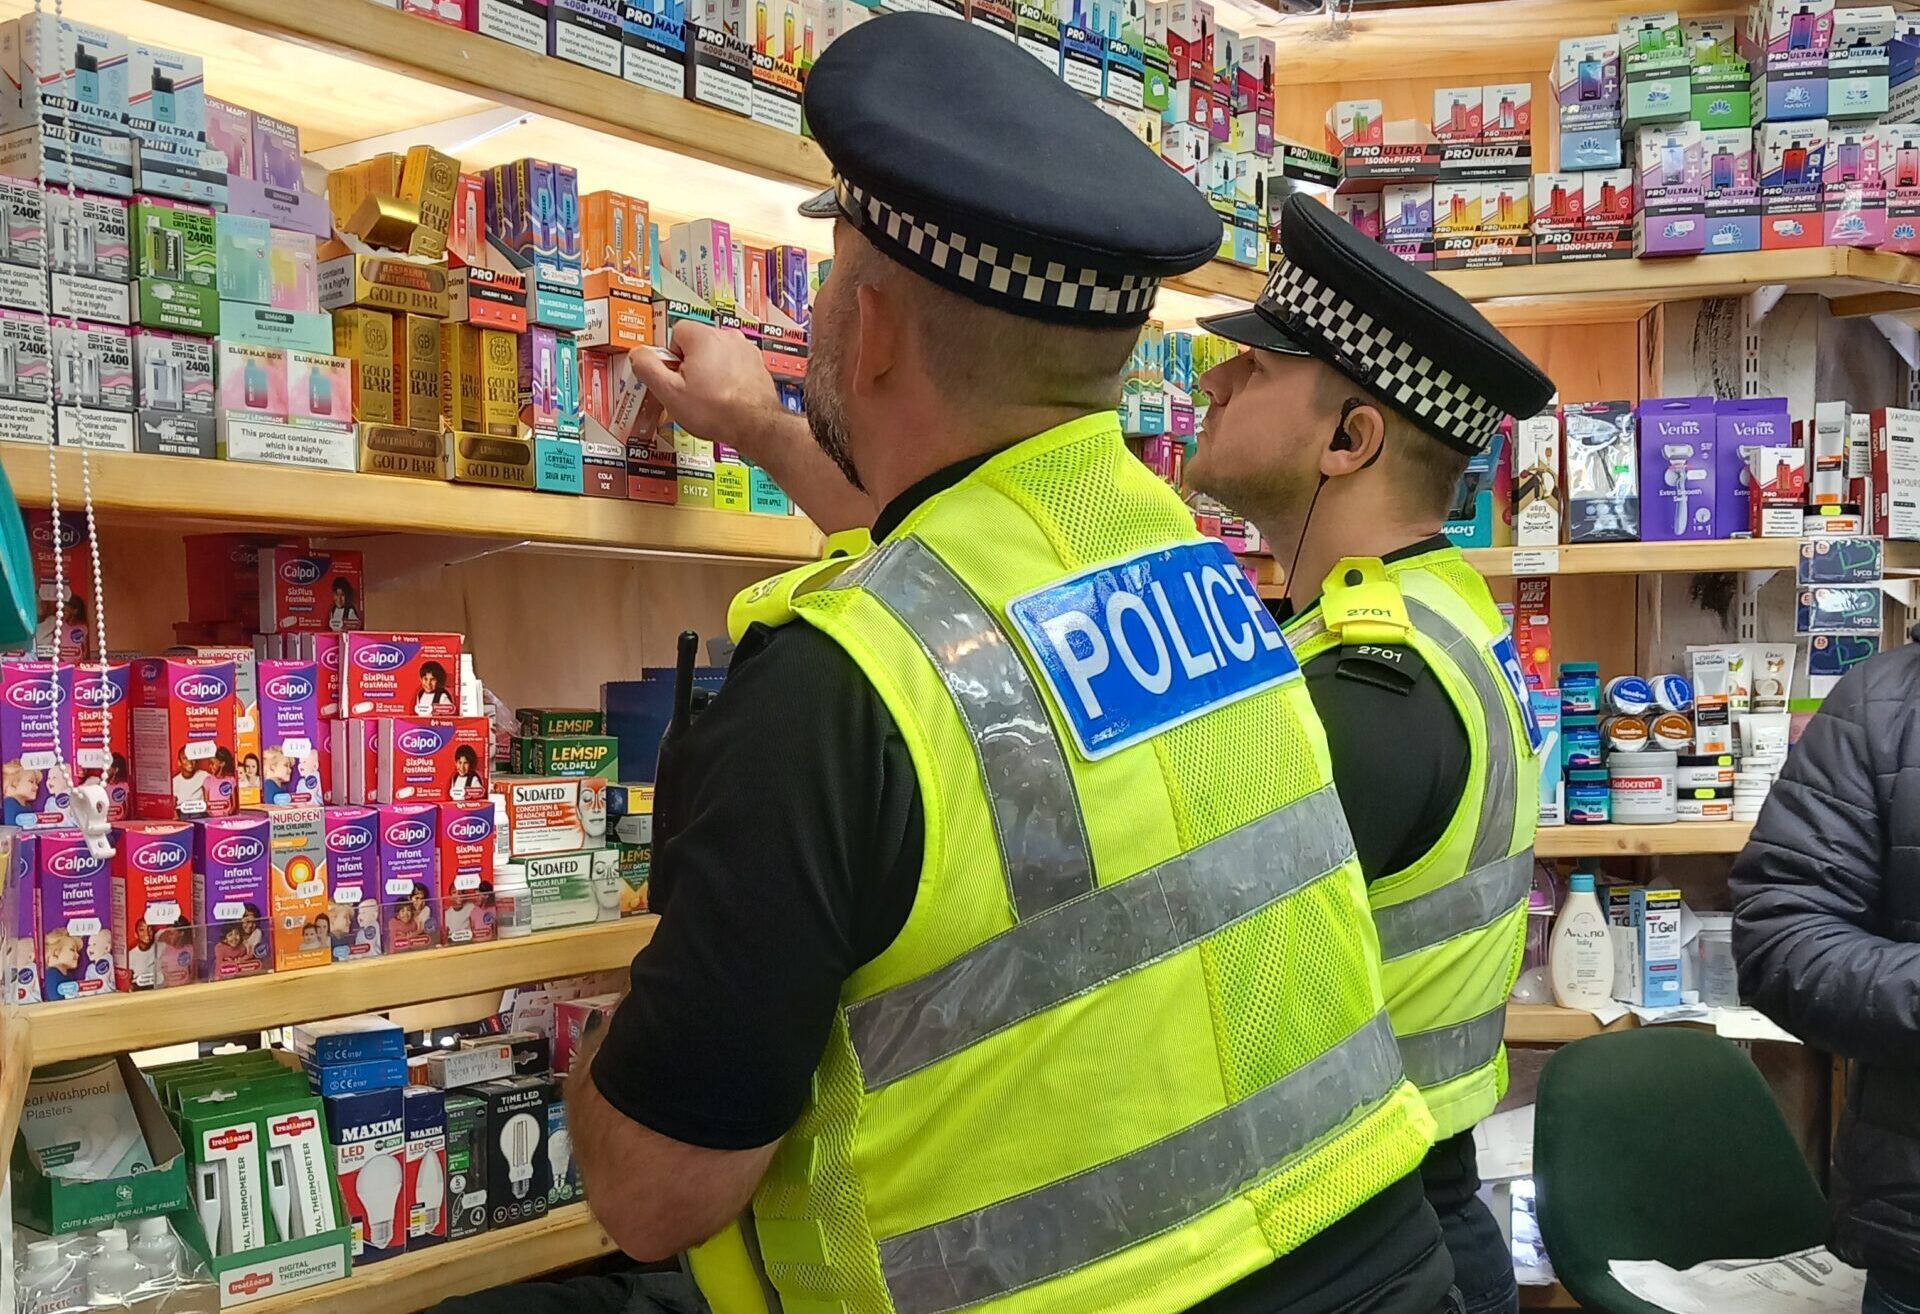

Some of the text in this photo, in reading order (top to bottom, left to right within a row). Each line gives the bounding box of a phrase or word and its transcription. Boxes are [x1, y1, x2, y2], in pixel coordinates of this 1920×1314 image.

[592, 7, 618, 24] PUFFS
[1020, 5, 1040, 20] PRO
[625, 8, 679, 36] PRO MAX
[698, 27, 748, 56] PRO MAX
[1110, 40, 1128, 55] PRO
[703, 45, 749, 67] 4000+ PUFFS
[1769, 50, 1823, 62] PRO ULTRA+
[1829, 49, 1884, 60] PRO ULTRA+
[752, 52, 797, 78] PRO MAX
[754, 67, 798, 89] 4000+ PUFFS
[204, 98, 224, 111] LOST
[80, 104, 119, 121] ULTRA
[257, 116, 276, 128] LOST
[158, 124, 194, 139] ULTRA
[143, 139, 174, 153] MINI
[1353, 145, 1423, 157] PRO ULTRA
[1445, 147, 1513, 159] PRO ULTRA
[1291, 148, 1331, 164] PRO ULTRA
[1365, 155, 1421, 164] 15000+PUFFS
[1647, 187, 1700, 197] PRO ULTRA+
[1763, 187, 1782, 196] PRO
[1827, 182, 1845, 191] PRO
[421, 200, 449, 220] GOLD
[98, 222, 125, 237] 2400
[187, 231, 213, 244] 2400
[1444, 240, 1471, 249] PRO
[1545, 232, 1614, 243] PRO ULTRA
[1556, 242, 1613, 251] 15000+PUFFS
[470, 267, 520, 289] PRO MINI
[369, 286, 438, 310] GOLD BAR
[669, 301, 711, 318] PRO MINI
[722, 316, 740, 328] PRO
[763, 324, 803, 340] PRO MINI
[102, 352, 129, 366] 2400
[172, 351, 197, 361] CRYSTAL
[228, 346, 282, 361] ELUX MAX BOX
[185, 360, 210, 373] 2400
[294, 354, 346, 369] ELUX MAX BOX
[362, 363, 391, 378] GOLD
[410, 369, 438, 384] GOLD
[362, 375, 391, 394] BAR
[488, 376, 515, 390] GOLD
[411, 382, 439, 399] BAR
[488, 387, 517, 404] BAR
[1659, 422, 1700, 435] Venus
[1734, 422, 1775, 436] Venus
[241, 427, 317, 445] This product contains
[265, 441, 287, 452] which
[301, 444, 323, 456] highly
[259, 450, 331, 465] addictive substance.
[629, 448, 671, 464] PRO MINI
[373, 454, 436, 475] GOLD BAR
[467, 463, 525, 482] GOLD BAR
[598, 472, 613, 481] COLA
[683, 487, 708, 497] SKITZ
[284, 564, 315, 580] Calpol
[1853, 569, 1872, 577] Lyco
[288, 588, 313, 596] SixPlus
[1520, 582, 1548, 591] DEEP
[1521, 592, 1546, 602] HEAT
[1347, 608, 1391, 618] 2701
[1853, 617, 1872, 625] Lyco
[1041, 564, 1284, 720] POLICE
[359, 651, 399, 666] Calpol
[1357, 645, 1402, 663] 2701
[362, 673, 395, 682] SixPlus
[179, 682, 222, 700] Calpol
[270, 682, 308, 698] Calpol
[360, 681, 398, 689] FastMelts
[1620, 688, 1647, 700] Vaseline
[185, 707, 219, 716] SixPlus
[277, 712, 304, 722] Infant
[548, 719, 594, 734] LEMSIP
[1660, 725, 1688, 735] Vaseline
[403, 736, 438, 750] Calpol
[552, 746, 608, 761] LEMSIP
[405, 758, 434, 767] SixPlus
[403, 766, 436, 774] FastMelts
[1612, 780, 1656, 790] Sudocrem
[516, 787, 565, 802] SUDAFED
[516, 804, 553, 814] CONGESTION
[516, 811, 546, 820] HEADACHE
[273, 813, 321, 824] NUROFEN
[273, 824, 286, 832] FOR
[390, 827, 426, 843] Calpol
[454, 822, 486, 837] Calpol
[330, 832, 368, 848] Calpol
[217, 844, 258, 861] Calpol
[396, 850, 423, 860] Infant
[456, 845, 484, 854] SixPlus
[55, 856, 98, 872] Calpol
[138, 849, 180, 866] Calpol
[224, 867, 253, 878] Infant
[336, 861, 363, 872] Infant
[530, 860, 578, 878] SUDAFED
[143, 875, 178, 885] SixPlus
[530, 880, 550, 888] MUCUS
[62, 888, 94, 900] Infant
[1649, 922, 1677, 934] T Gel
[501, 1090, 540, 1105] TIME LED
[26, 1103, 73, 1121] Plasters
[341, 1117, 403, 1143] MAXIM
[410, 1125, 443, 1140] MAXIM
[341, 1145, 365, 1158] LED
[409, 1142, 424, 1152] LED
[303, 1142, 320, 1216] THERMOMETER
[238, 1156, 249, 1229] THERMOMETER
[61, 1219, 81, 1229] CUTS
[88, 1213, 116, 1225] GRAZES
[117, 1211, 131, 1220] FOR
[132, 1208, 144, 1217] ALL
[146, 1205, 158, 1214] THE
[159, 1200, 182, 1213] FAMILY
[278, 1260, 309, 1274] DIGITAL
[279, 1261, 337, 1281] THERMOMETER
